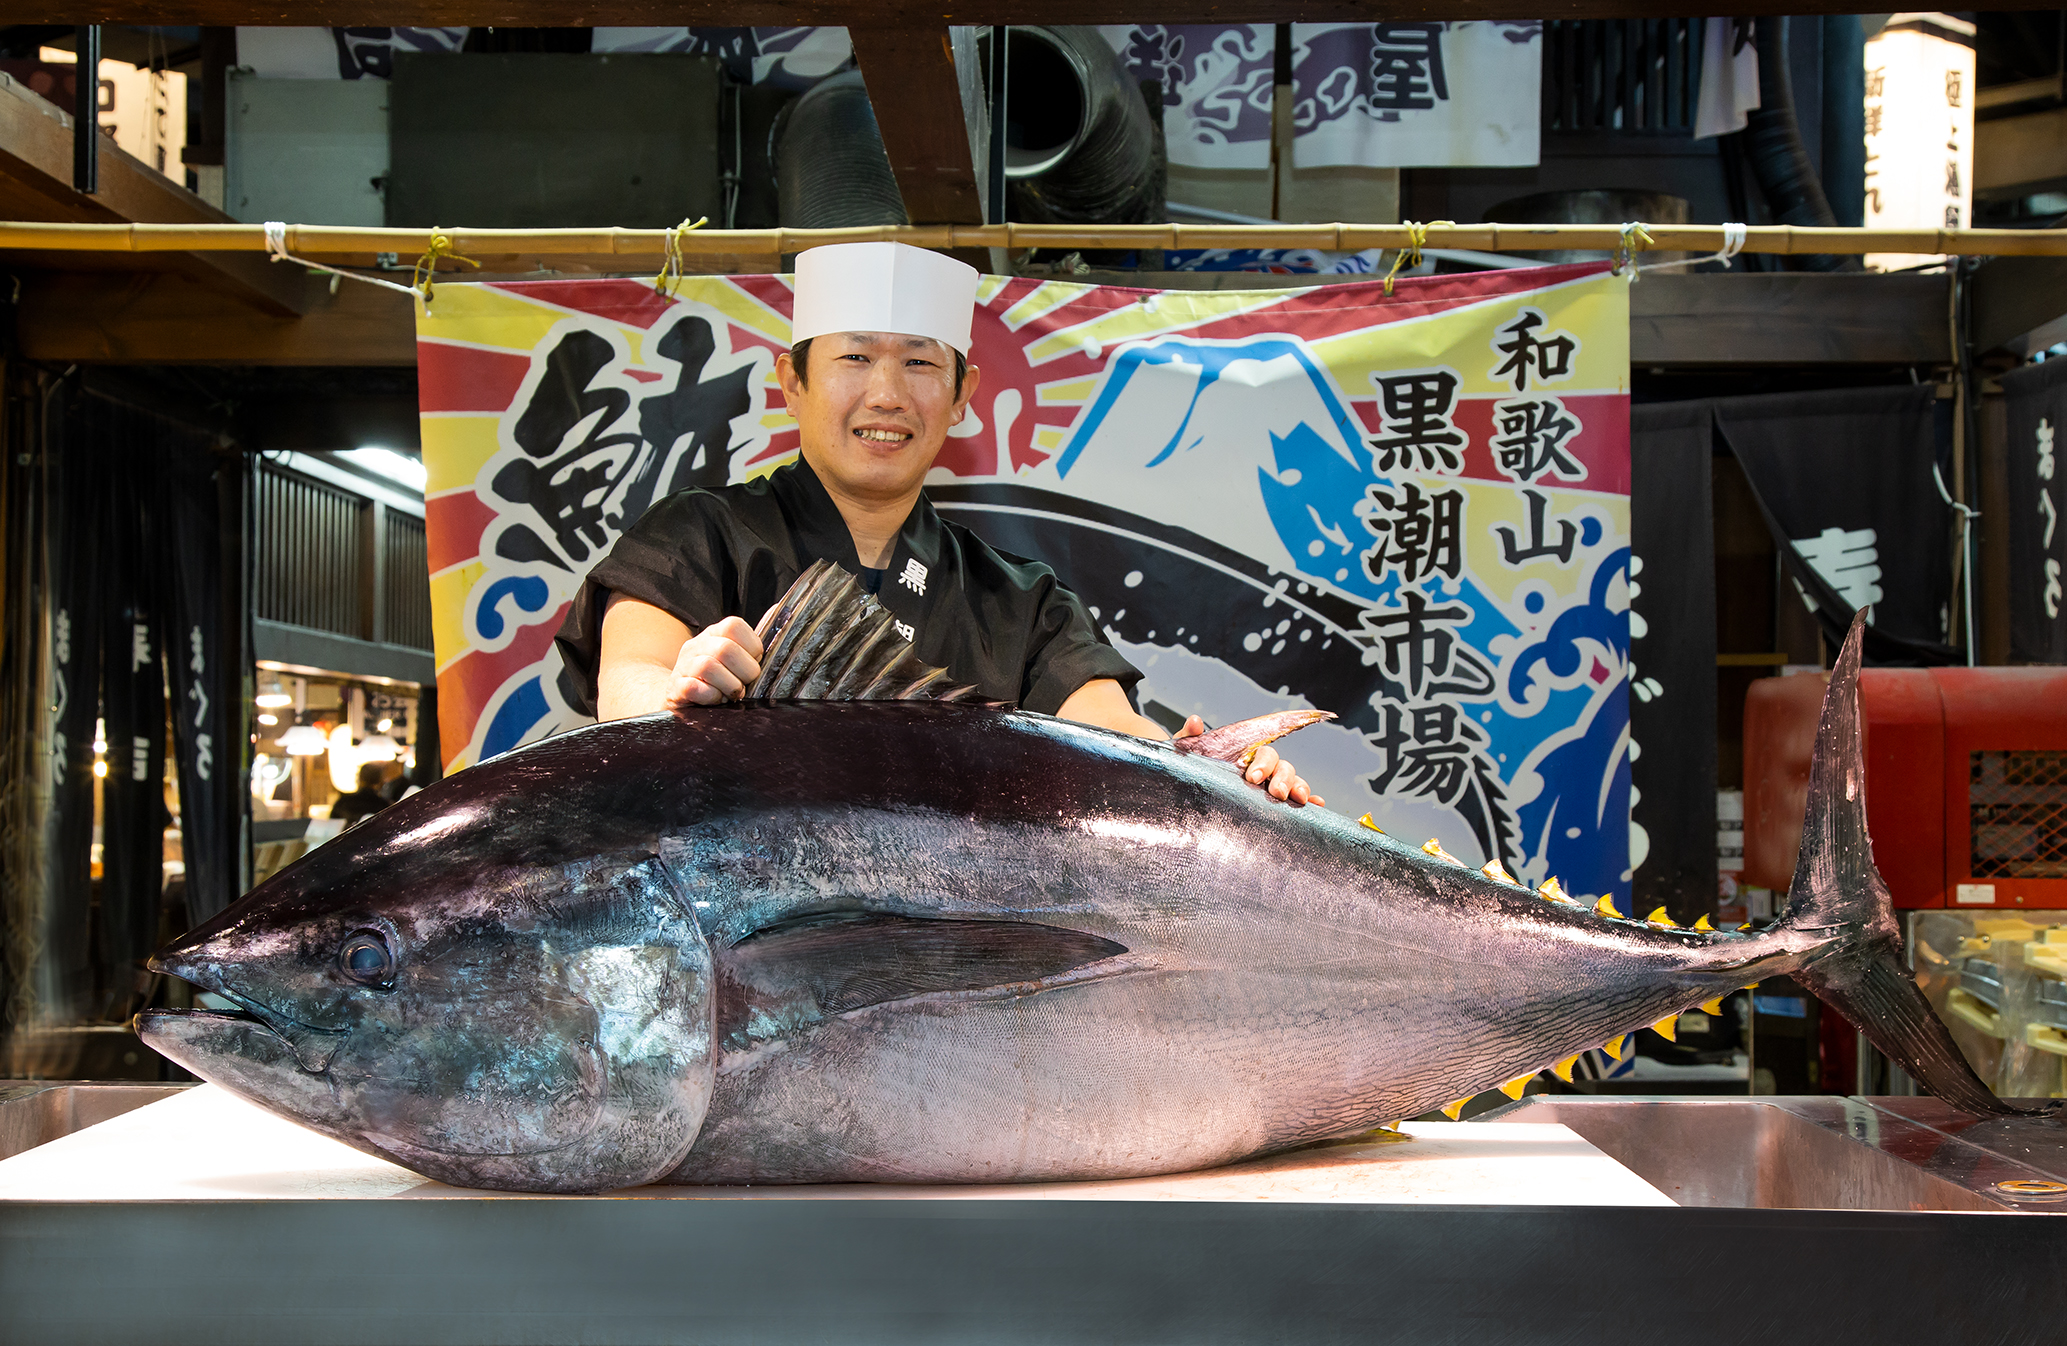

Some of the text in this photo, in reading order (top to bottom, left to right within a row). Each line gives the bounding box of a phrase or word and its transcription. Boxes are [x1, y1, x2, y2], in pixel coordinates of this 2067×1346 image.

[1365, 371, 1471, 805] 黒潮市場
[1494, 311, 1583, 565] 和歌山
